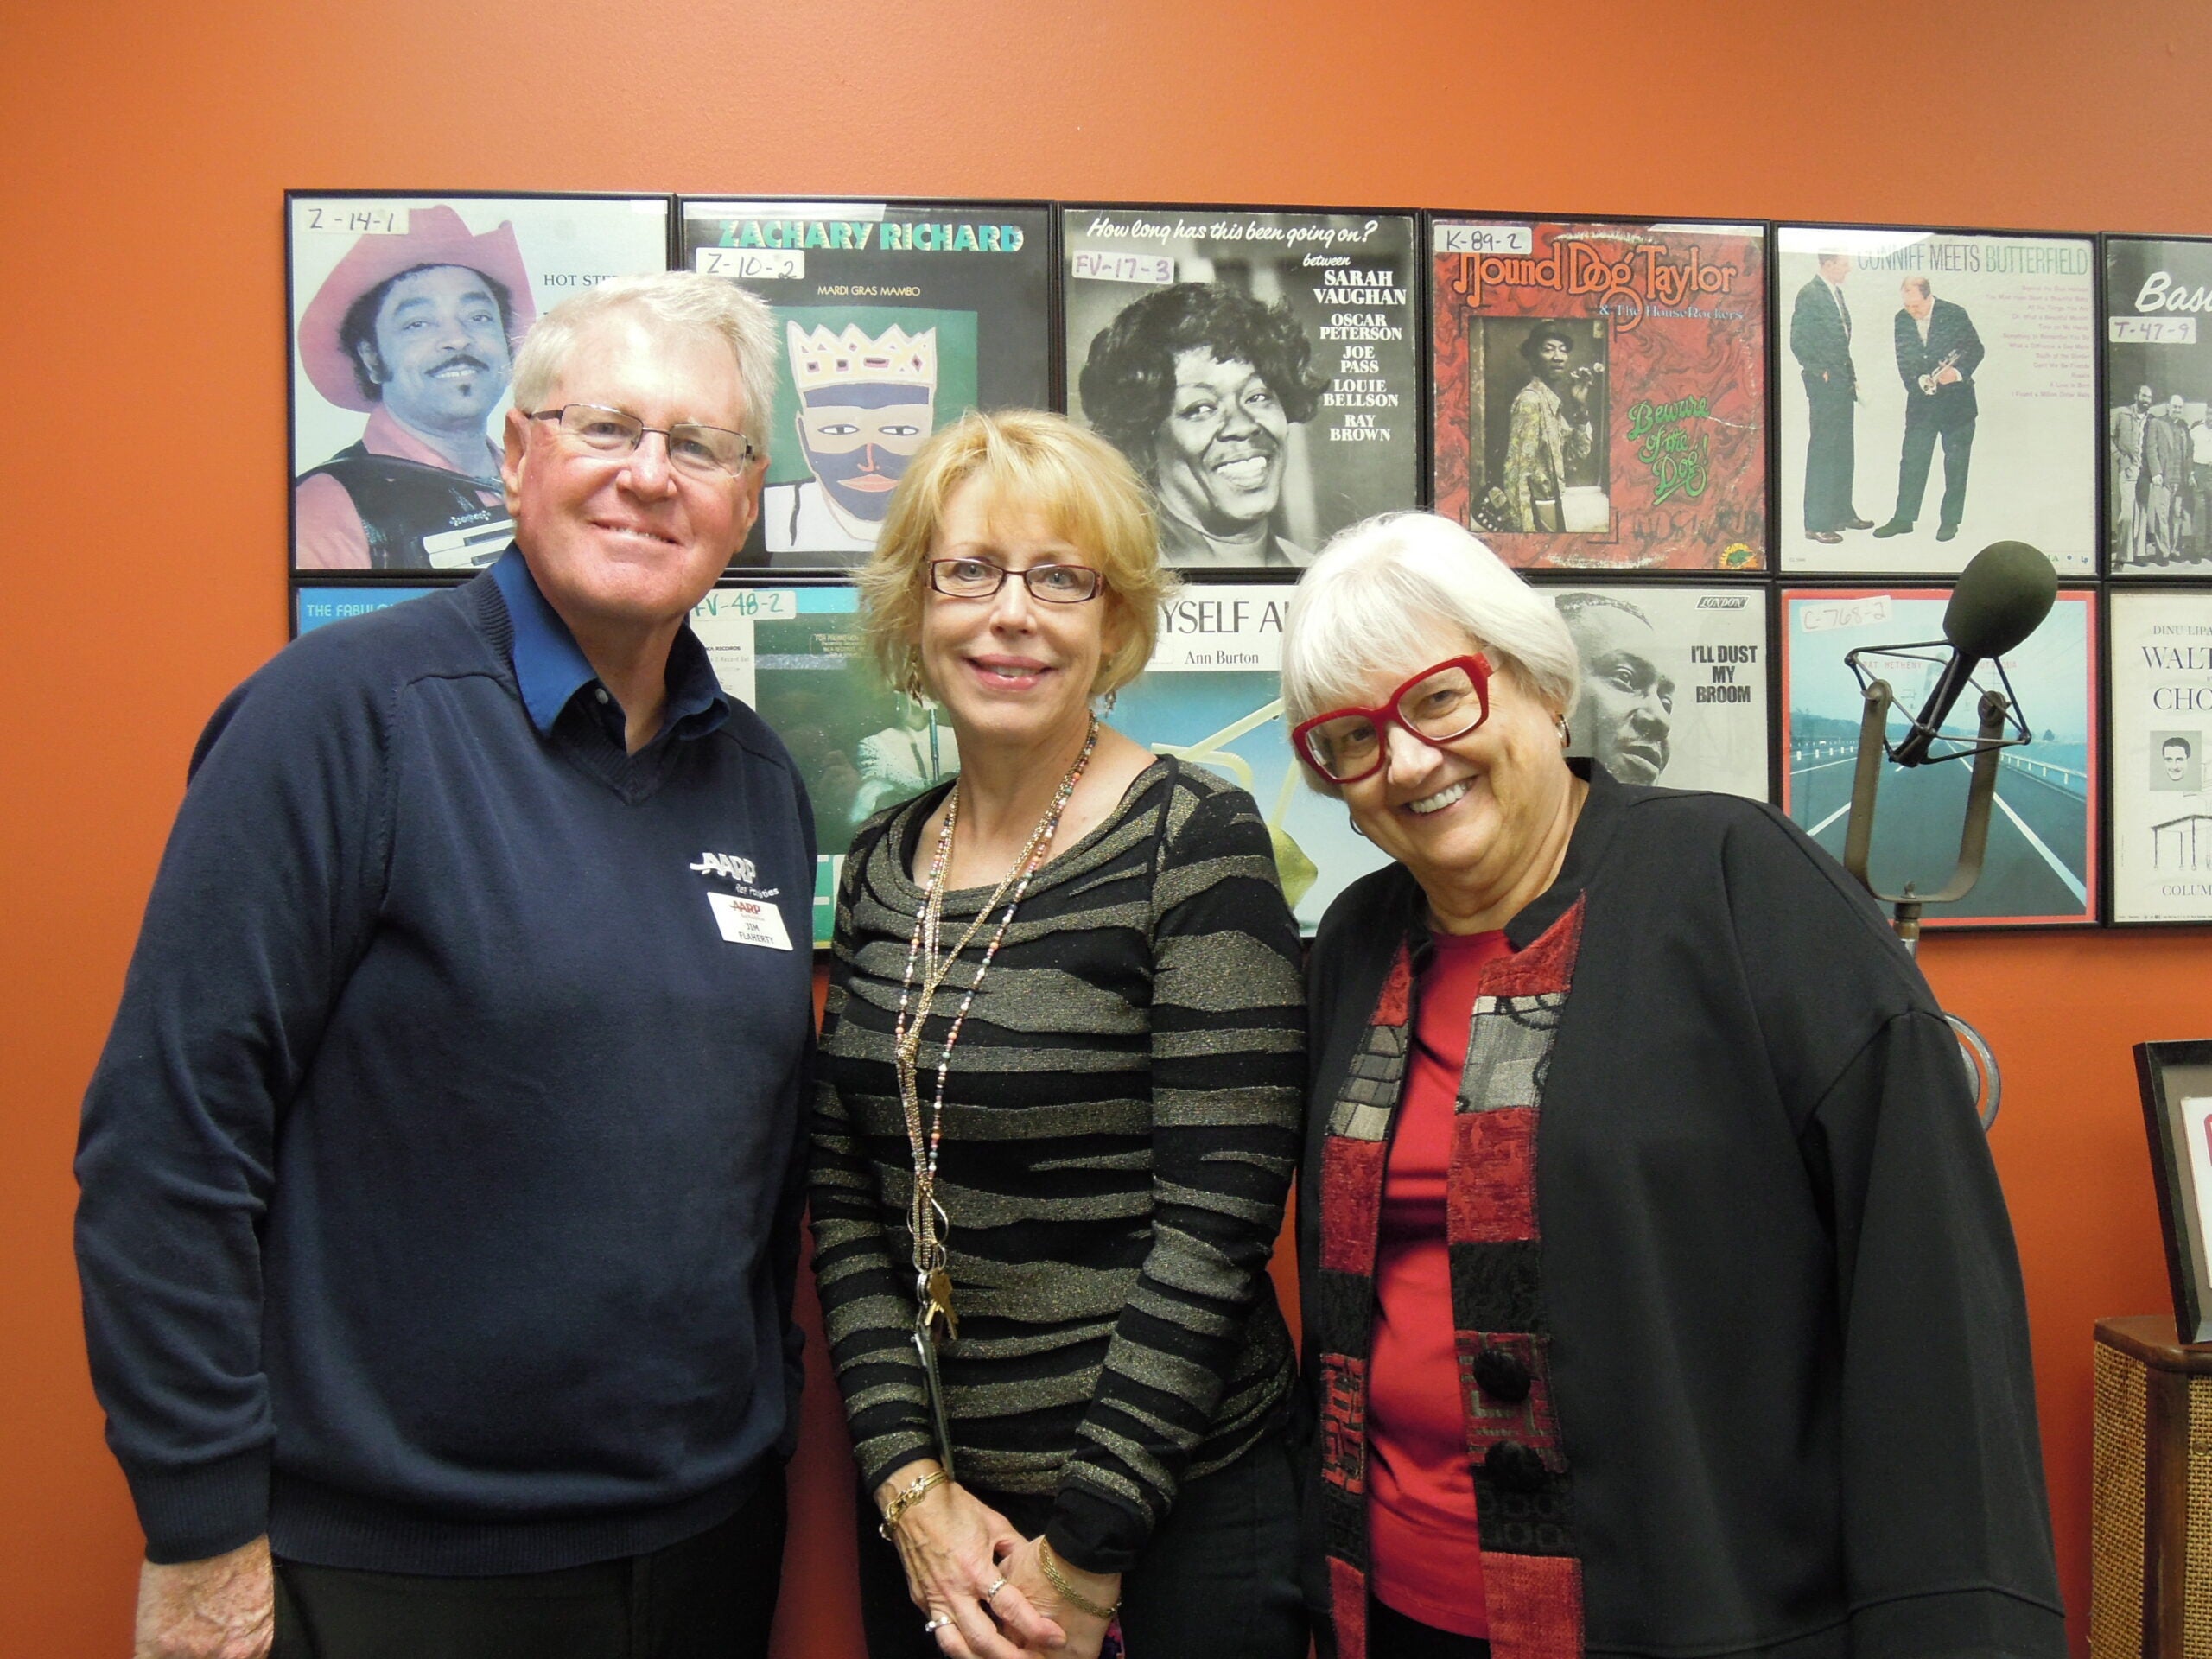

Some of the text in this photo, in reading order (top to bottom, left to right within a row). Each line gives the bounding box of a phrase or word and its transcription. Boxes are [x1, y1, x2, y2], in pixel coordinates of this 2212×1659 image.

[719, 219, 1025, 252] ZACHARY RICHARD
[1086, 217, 1378, 248] How long has this been going on?
[1446, 230, 1523, 251] K-89-2
[707, 252, 796, 279] Z-10-2
[1302, 253, 1351, 268] between
[1858, 243, 2088, 276] CONNIFF MEETS BUTTERFIELD
[1077, 254, 1172, 282] FV-17-3
[543, 274, 578, 286] HOT
[1324, 270, 1394, 287] SARAH
[1453, 240, 1738, 332] Hound Dog Taylor
[817, 285, 921, 297] MARDI GRAS MAMBO
[1313, 289, 1407, 306] VAUGHAN
[1599, 304, 1610, 315] &
[1617, 303, 1641, 316] The
[1330, 313, 1387, 327] OSCAR
[1319, 327, 1402, 340] PETERSON
[2113, 321, 2190, 341] T-47-9
[1342, 346, 1376, 359] JOE
[1339, 359, 1379, 373] PASS
[1333, 379, 1387, 393] LOUIE
[1323, 393, 1399, 407] BELLSON
[1344, 414, 1376, 428] RAY
[1628, 394, 1711, 442] Beware
[1329, 428, 1391, 442] BROWN
[1638, 428, 1688, 464] of the
[306, 604, 332, 617] THE
[1700, 597, 1745, 609] LONDON
[1258, 601, 1289, 633] A
[1803, 601, 1886, 631] C-768-2
[2152, 626, 2183, 635] DINU
[1185, 650, 1260, 664] Ann Burton
[1690, 645, 1758, 664] I'LL DUST
[2141, 646, 2212, 670] WALT
[1884, 661, 1923, 670] METHENY
[1712, 665, 1736, 683] MY
[1695, 685, 1751, 703] BROOM
[2152, 687, 2212, 711] CHO
[690, 852, 756, 884] AARP
[2162, 884, 2212, 897] COLUM
[728, 900, 761, 915] AARP
[746, 922, 760, 932] JIM
[738, 931, 775, 945] FLAHERTY
